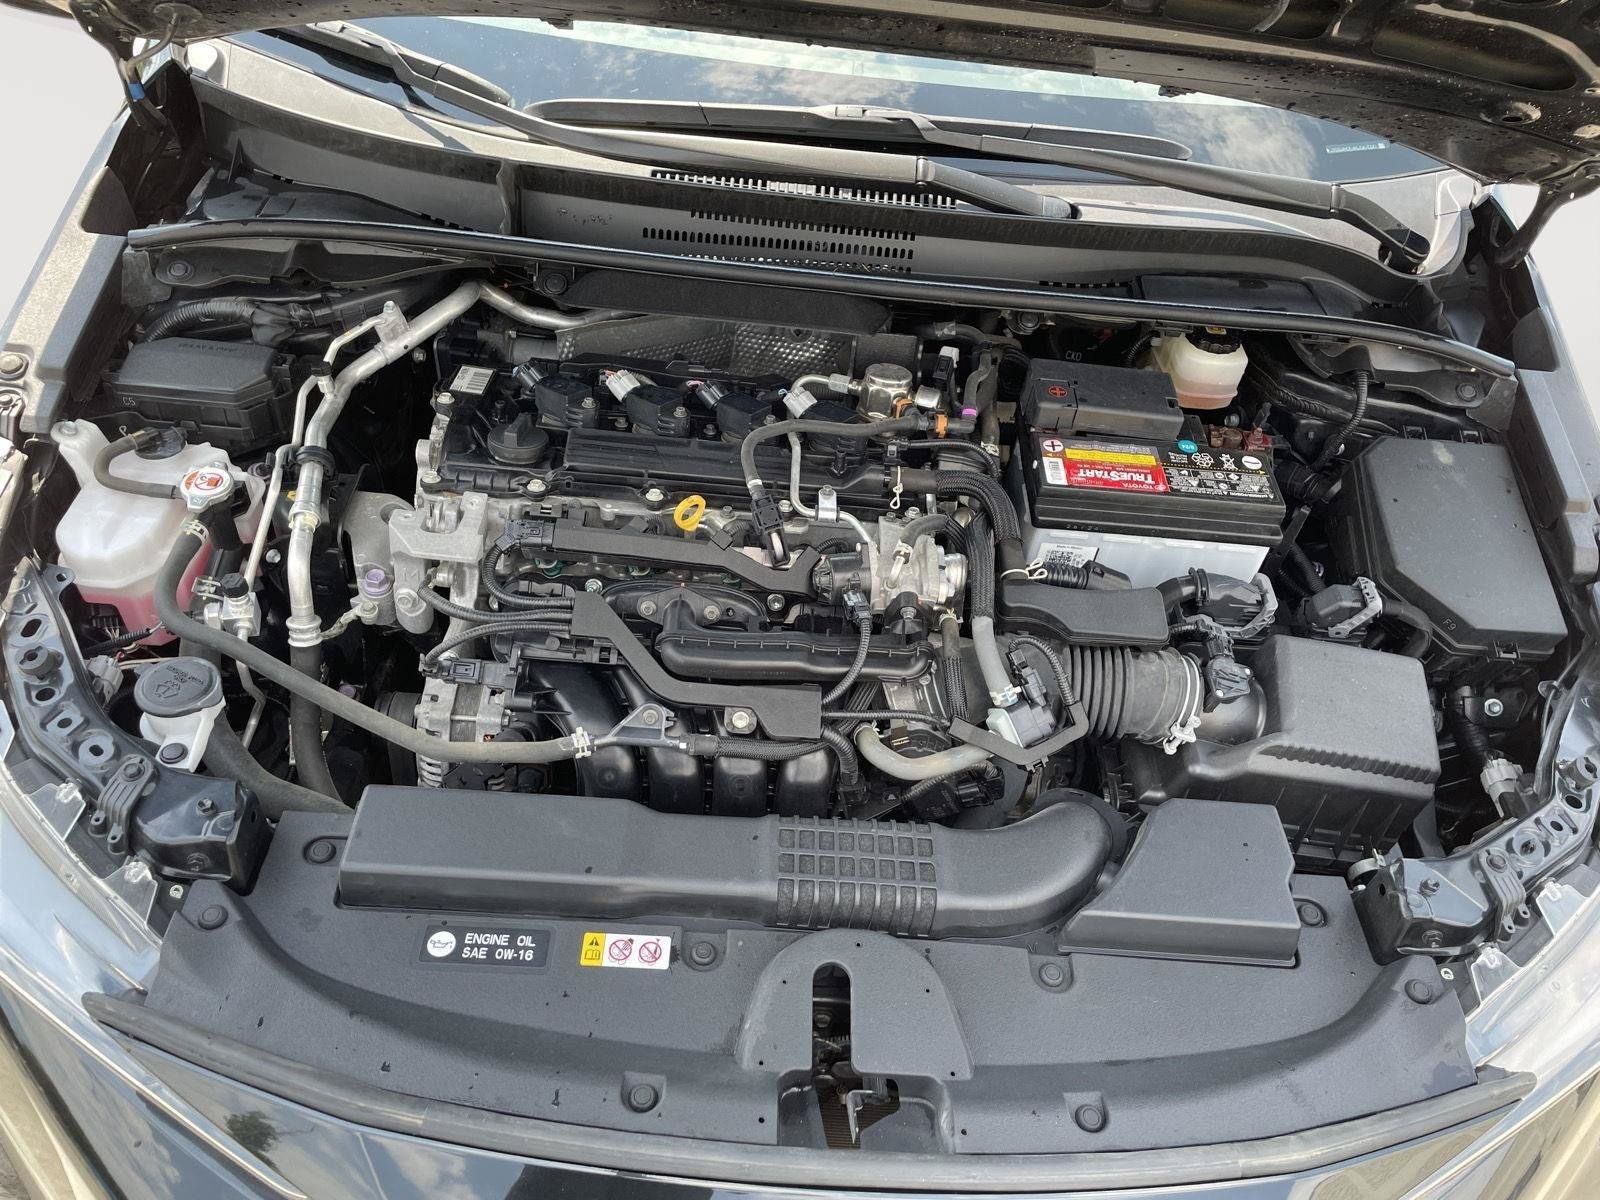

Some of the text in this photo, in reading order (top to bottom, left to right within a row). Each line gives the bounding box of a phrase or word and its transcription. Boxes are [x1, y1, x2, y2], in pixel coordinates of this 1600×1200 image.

[1121, 482, 1154, 490] TOYOTA
[1442, 618, 1457, 631] F9
[464, 932, 536, 948] ENGINE OIL
[461, 946, 535, 961] SAE 0W-16
